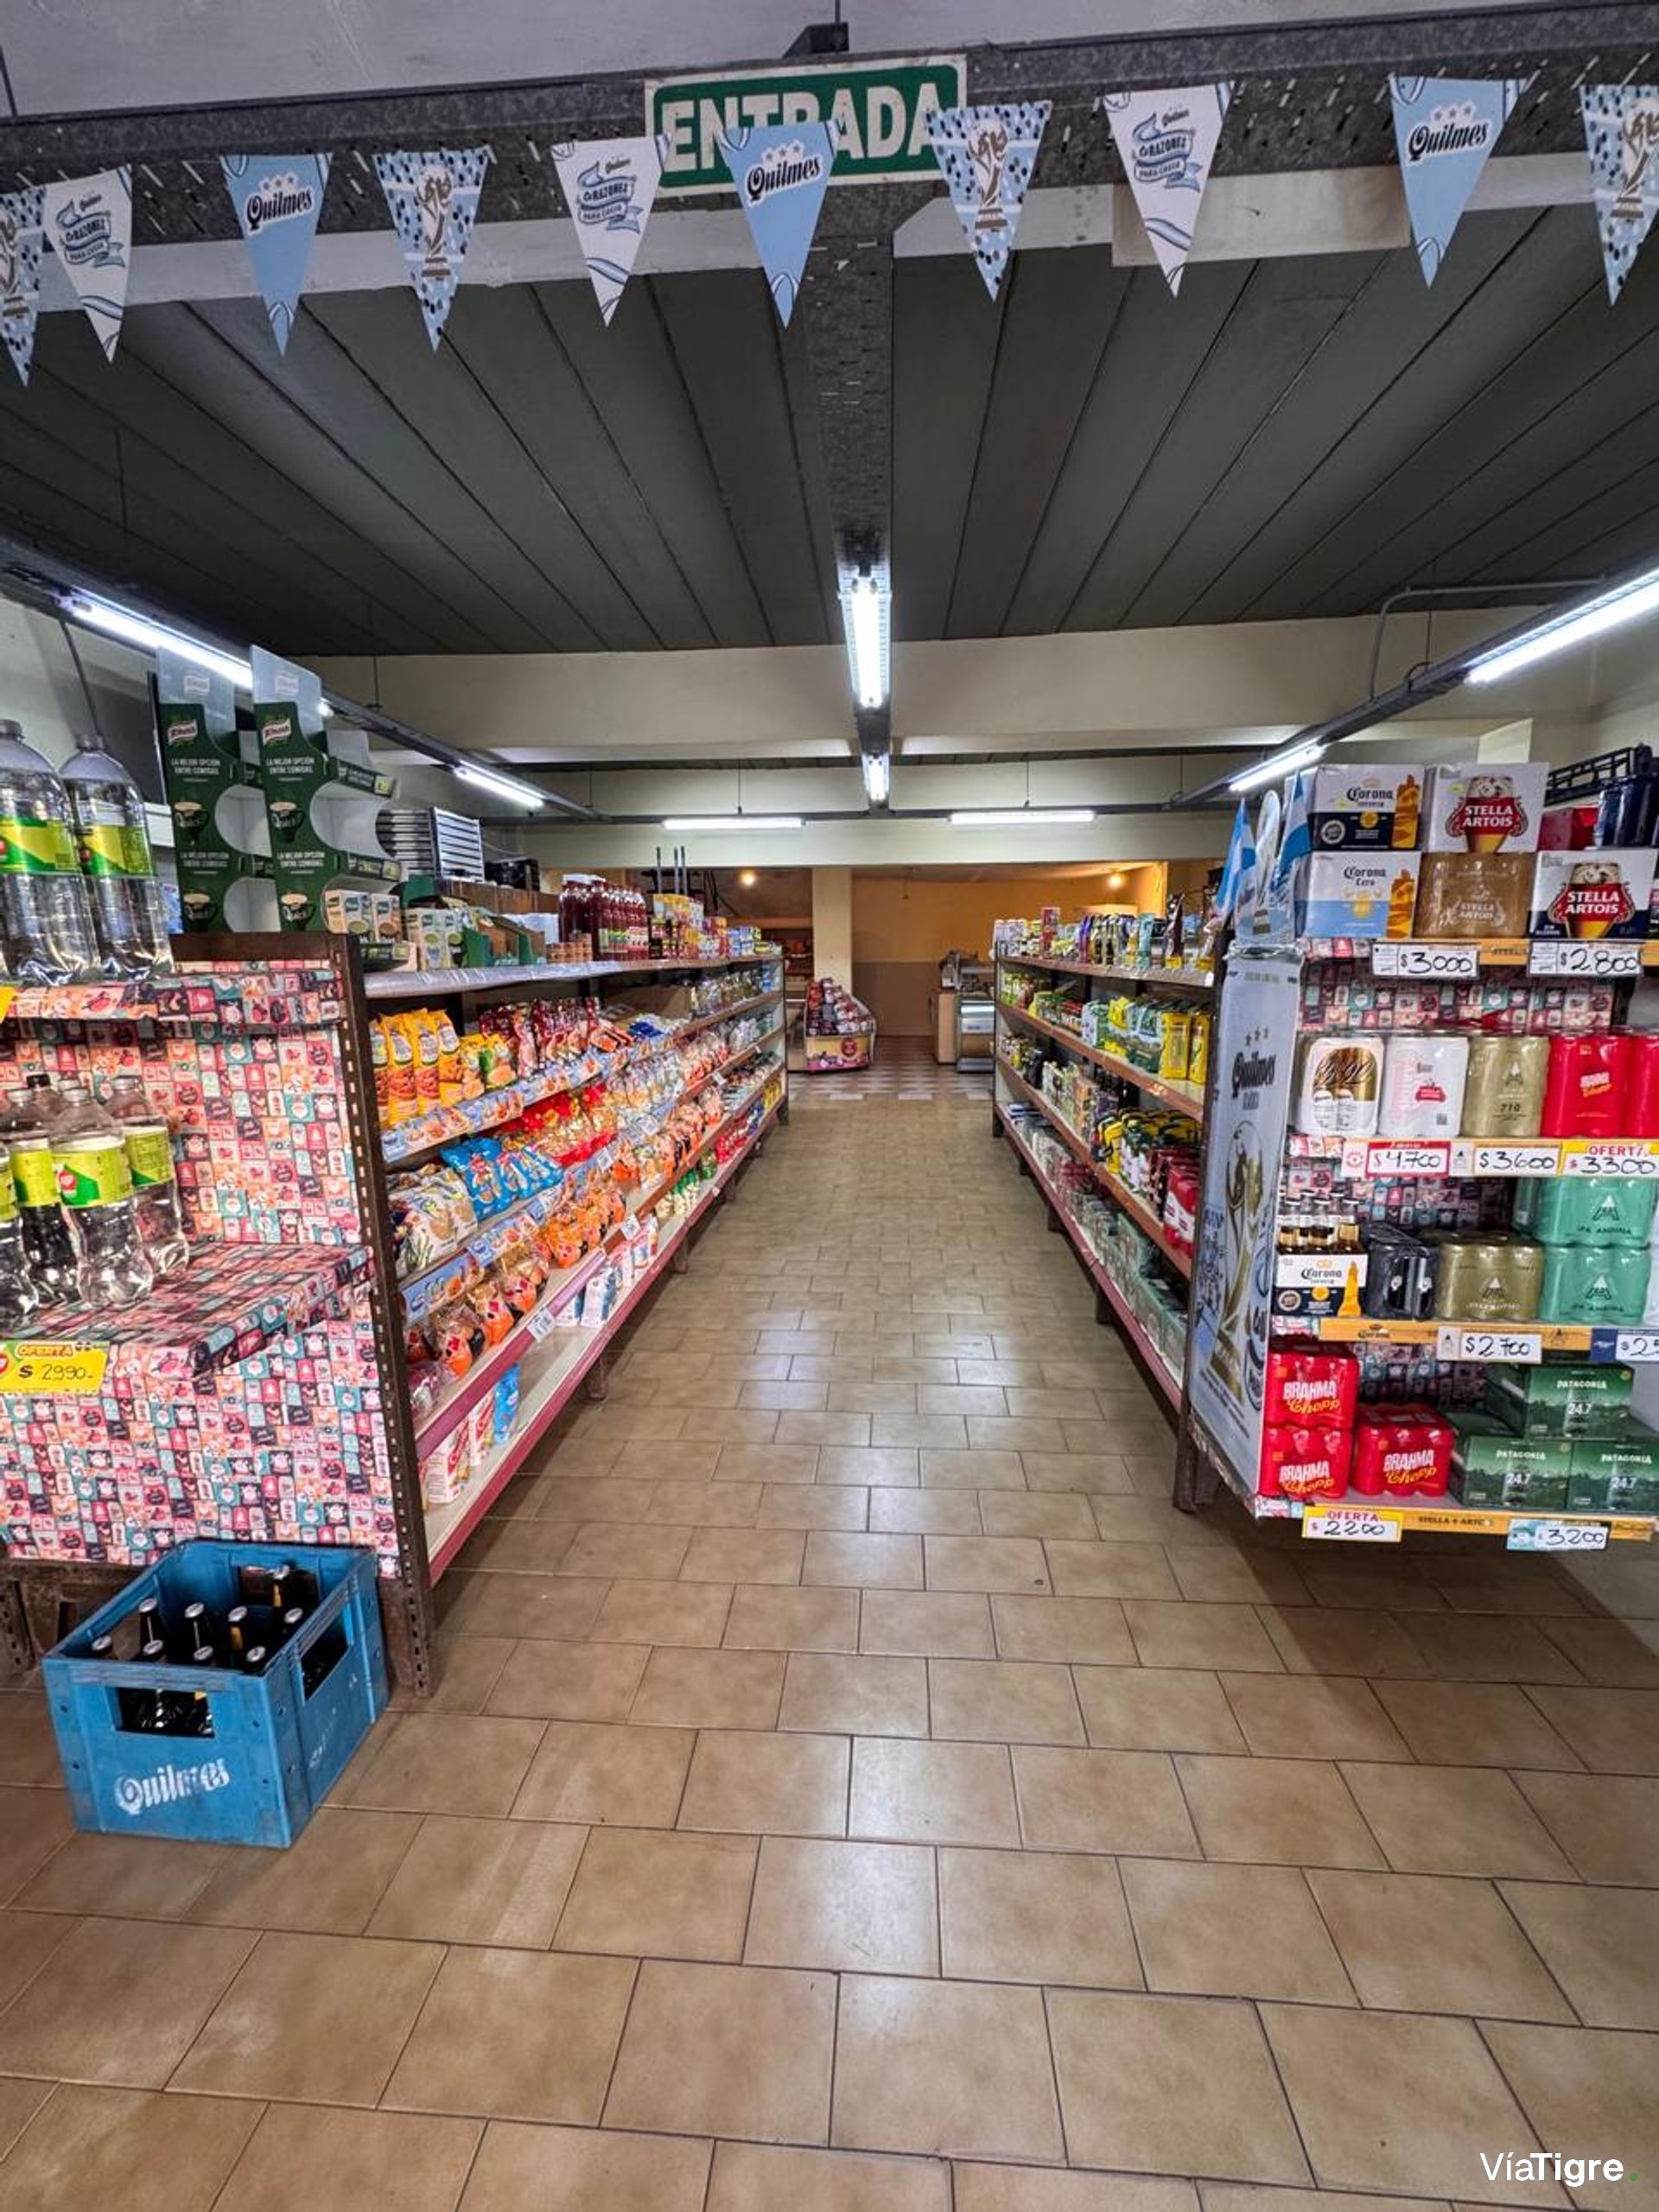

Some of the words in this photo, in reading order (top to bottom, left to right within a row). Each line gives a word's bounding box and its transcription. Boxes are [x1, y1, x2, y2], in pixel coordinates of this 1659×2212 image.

[1408, 121, 1489, 162] Quilmes
[746, 157, 821, 200] Quilmes
[247, 189, 313, 231] Quilmes
[1346, 785, 1394, 802] Corona
[1465, 804, 1514, 816] STELLA
[1463, 817, 1514, 828] ARTOIS
[1344, 866, 1387, 880] Corona
[1567, 891, 1620, 903] STELLA
[1565, 904, 1618, 914] ARTOIS
[1300, 1268, 1342, 1280] Corona
[18, 1344, 73, 1357] OFERTA
[1283, 1381, 1337, 1401] BRAHMA
[1556, 1380, 1607, 1389] PATAGONIA
[1287, 1398, 1340, 1414] Chopp
[1383, 1449, 1435, 1472] BRAHMA
[1496, 1449, 1547, 1460] PATAGONIA
[1601, 1453, 1652, 1465] PATAGONIA
[1279, 1461, 1331, 1484] BRAHMA
[1386, 1466, 1437, 1484] Chopp
[1282, 1478, 1334, 1494] Chopp
[1326, 1510, 1379, 1522] OFERTA
[113, 1758, 231, 1815] Quilmes
